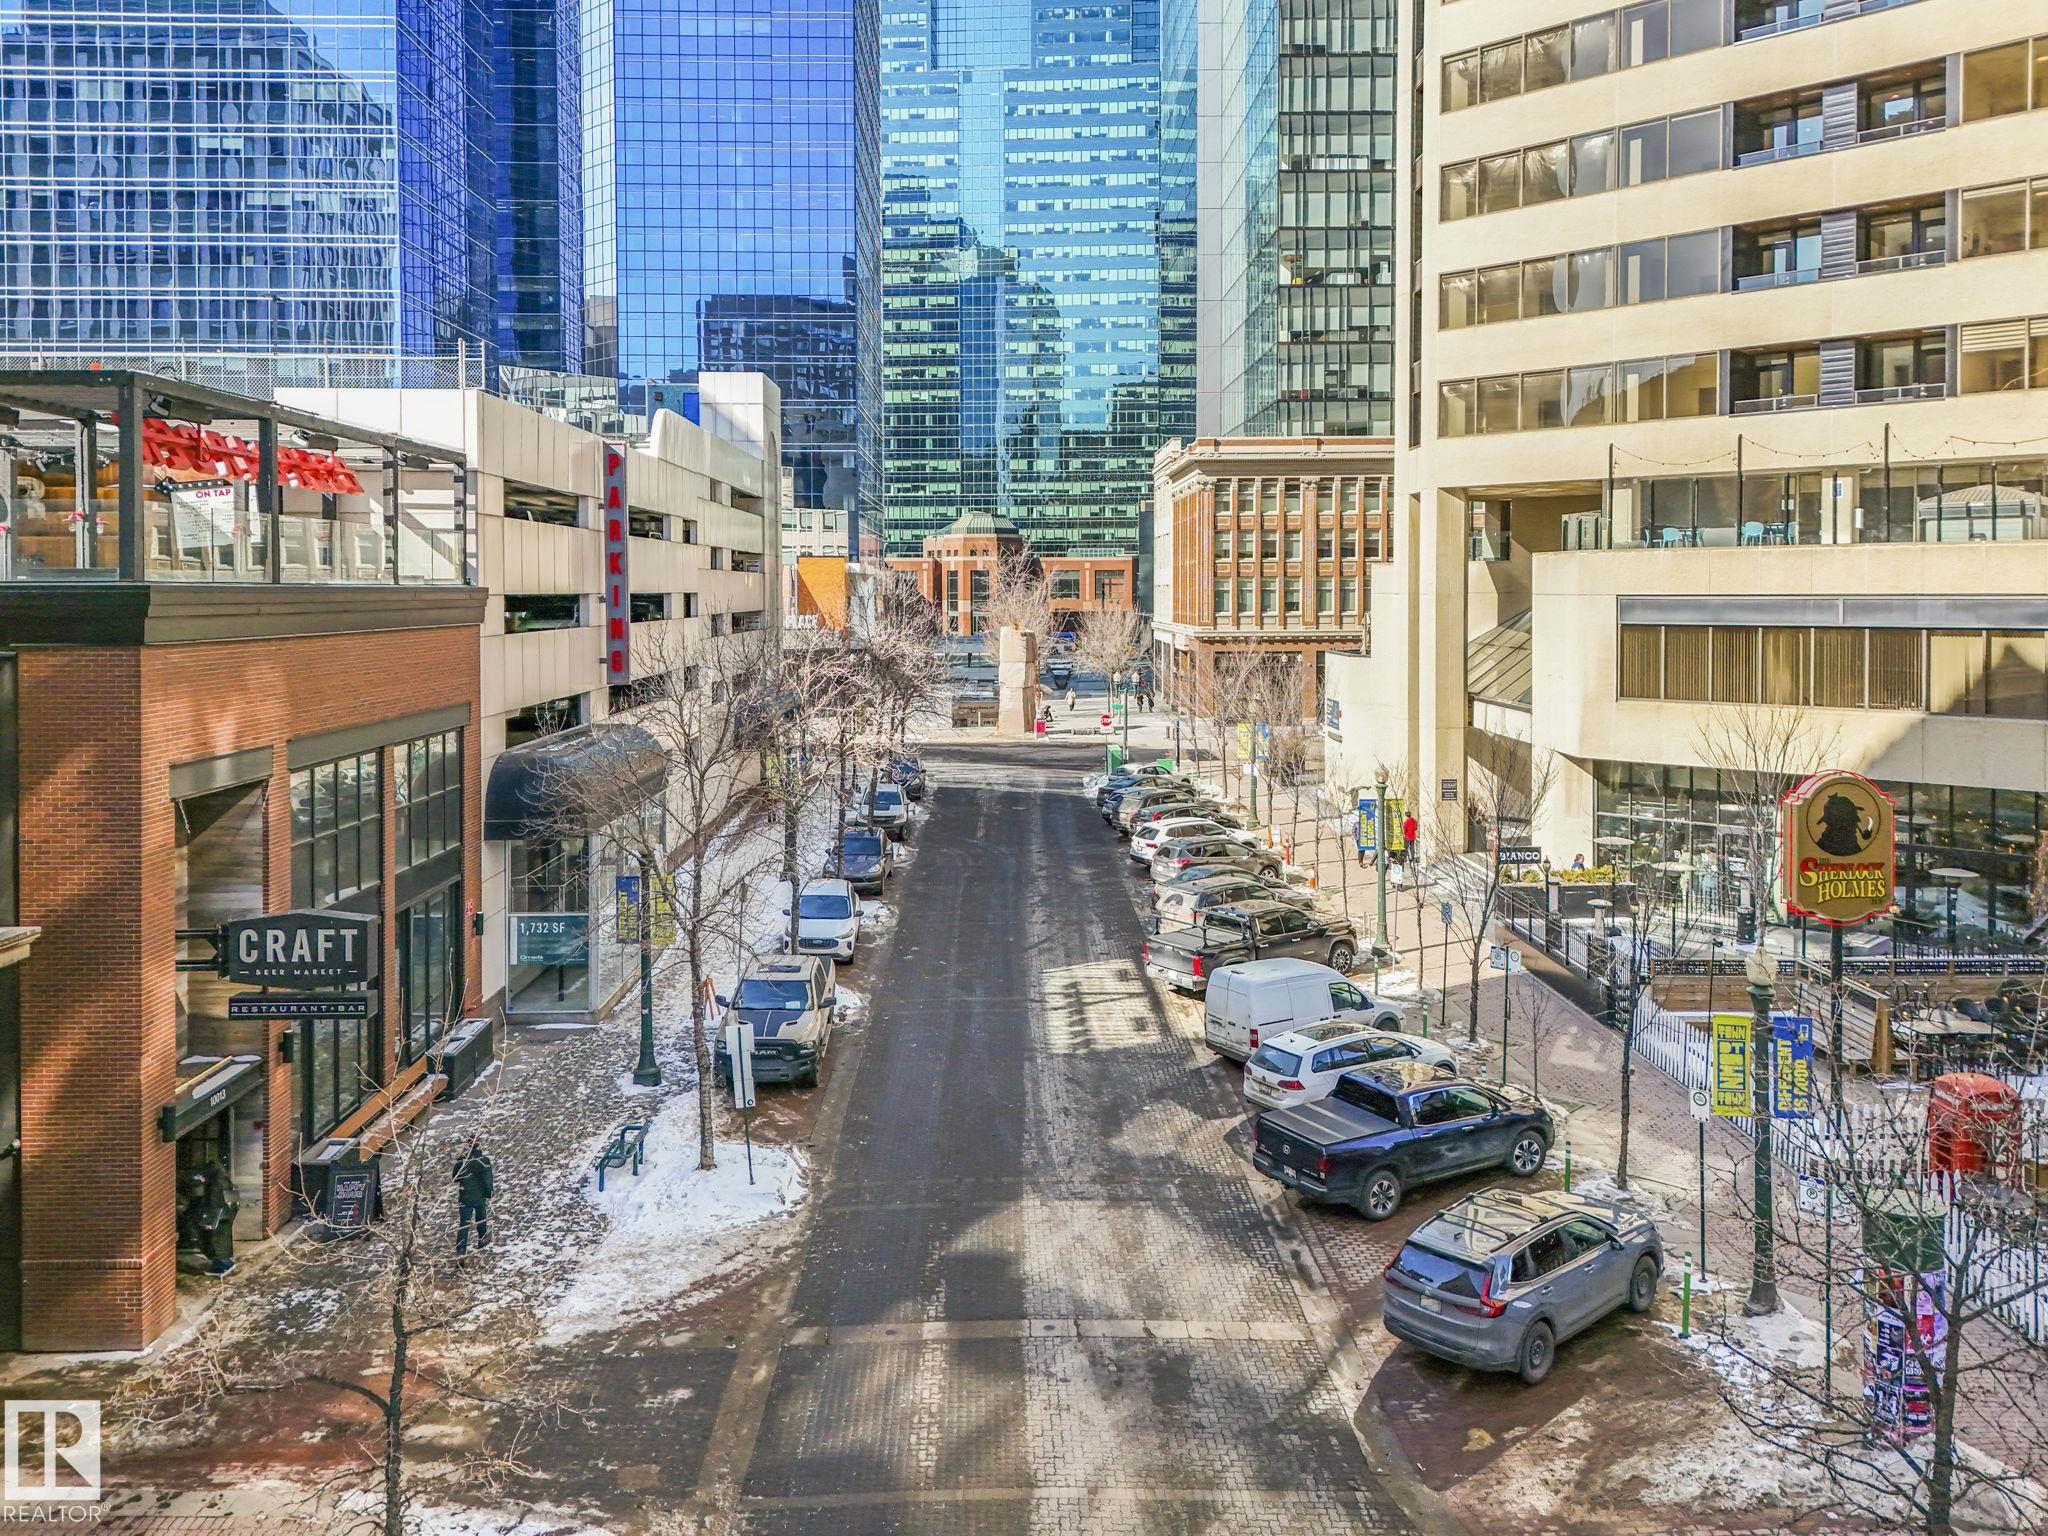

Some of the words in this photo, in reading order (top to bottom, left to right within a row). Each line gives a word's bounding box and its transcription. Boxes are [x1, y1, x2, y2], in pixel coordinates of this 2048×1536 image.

[196, 490, 210, 498] ON
[214, 488, 231, 496] TAP
[608, 453, 623, 673] PARKING
[1817, 879, 1886, 904] HOLMES
[519, 922, 549, 936] 1,732
[552, 922, 565, 933] SF
[239, 928, 358, 963] CRAFT
[294, 968, 341, 976] MARKET
[210, 1089, 226, 1107] 10013
[337, 1183, 366, 1192] HAPPY
[338, 1191, 363, 1199] HOUR
